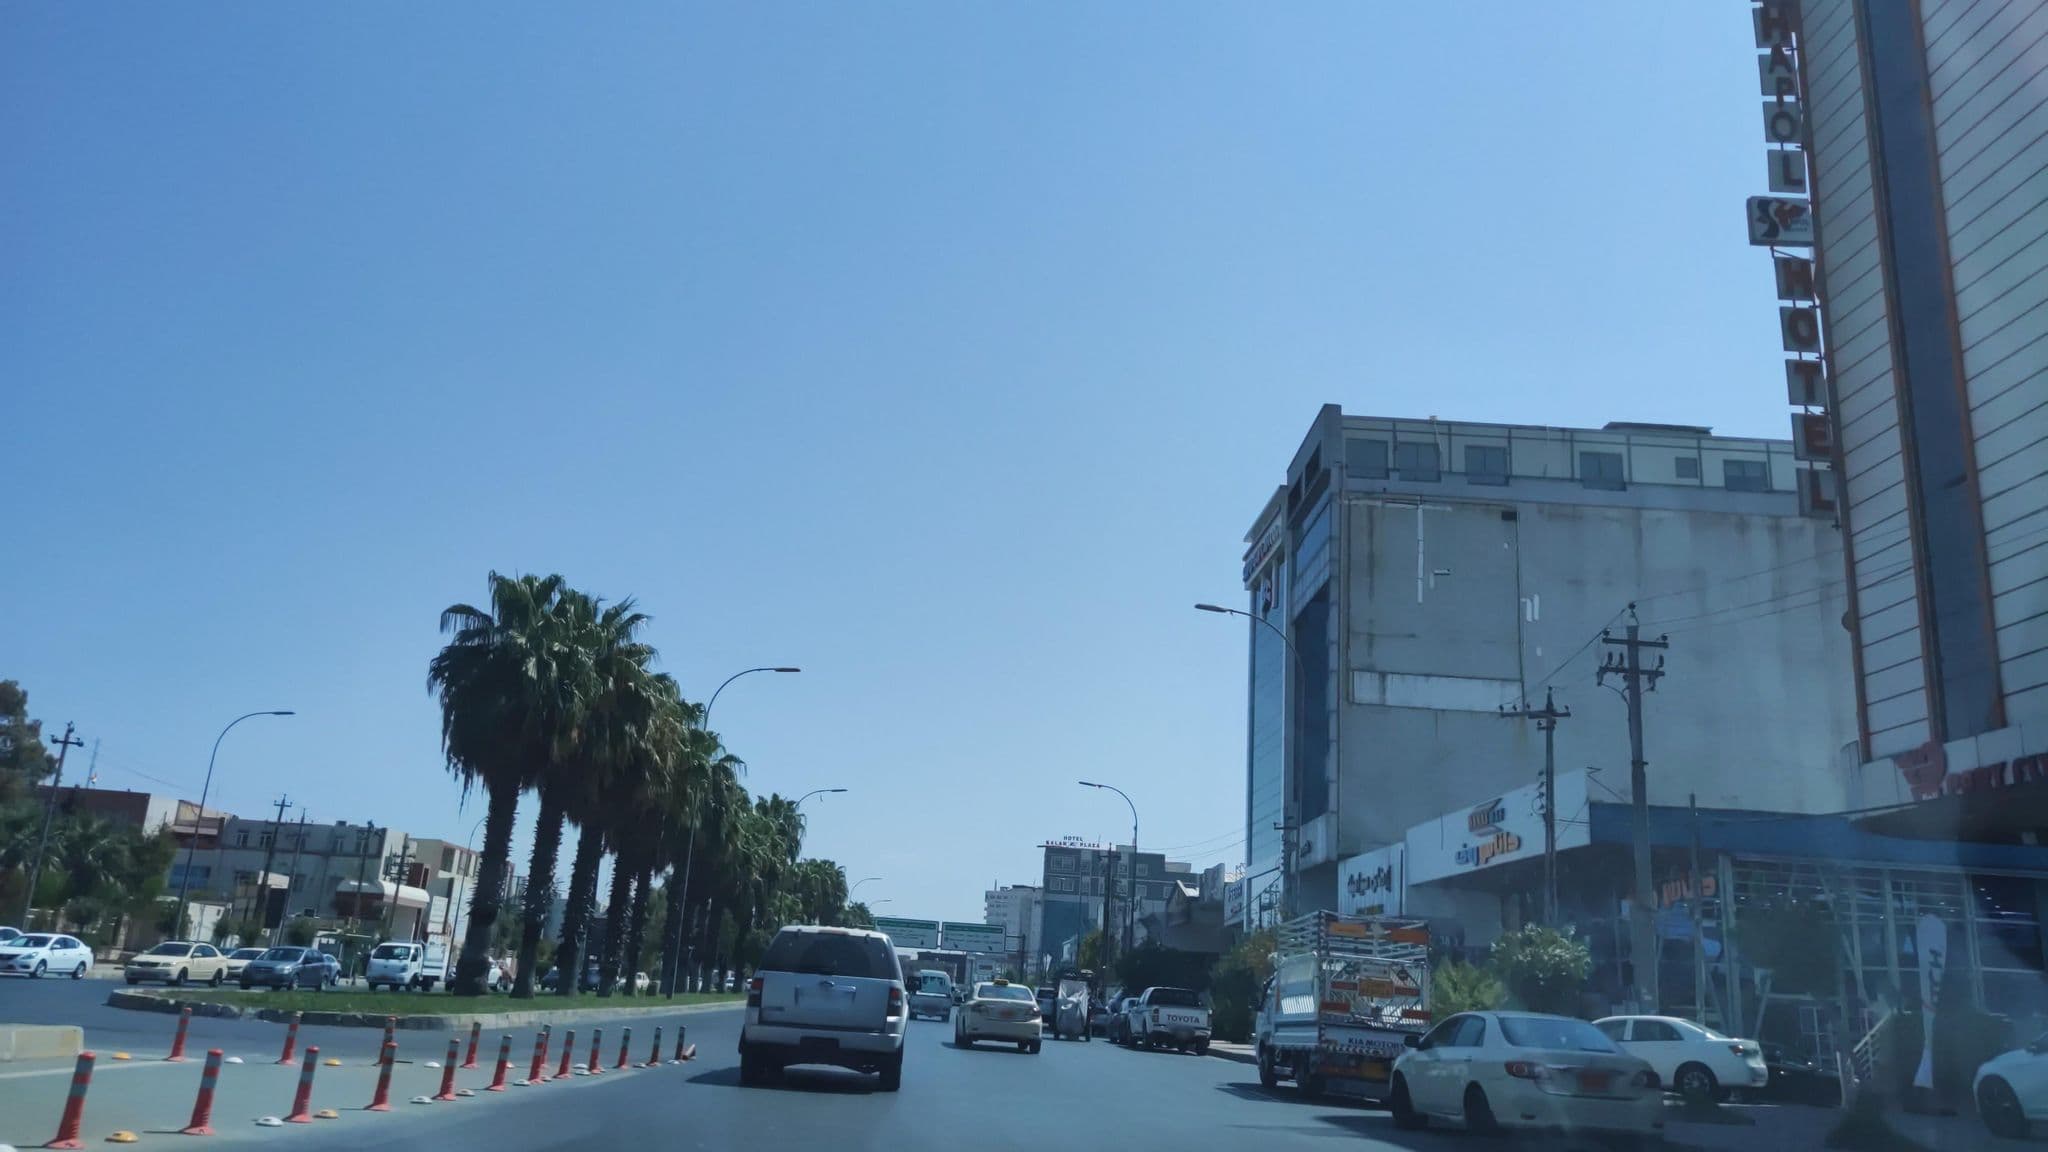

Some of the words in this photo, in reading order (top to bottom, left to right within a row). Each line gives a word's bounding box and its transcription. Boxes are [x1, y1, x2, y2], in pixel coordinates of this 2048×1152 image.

[1781, 258, 1837, 512] HOTEL
[1166, 1014, 1200, 1024] TOYOTA
[1348, 1037, 1364, 1045] KIA
